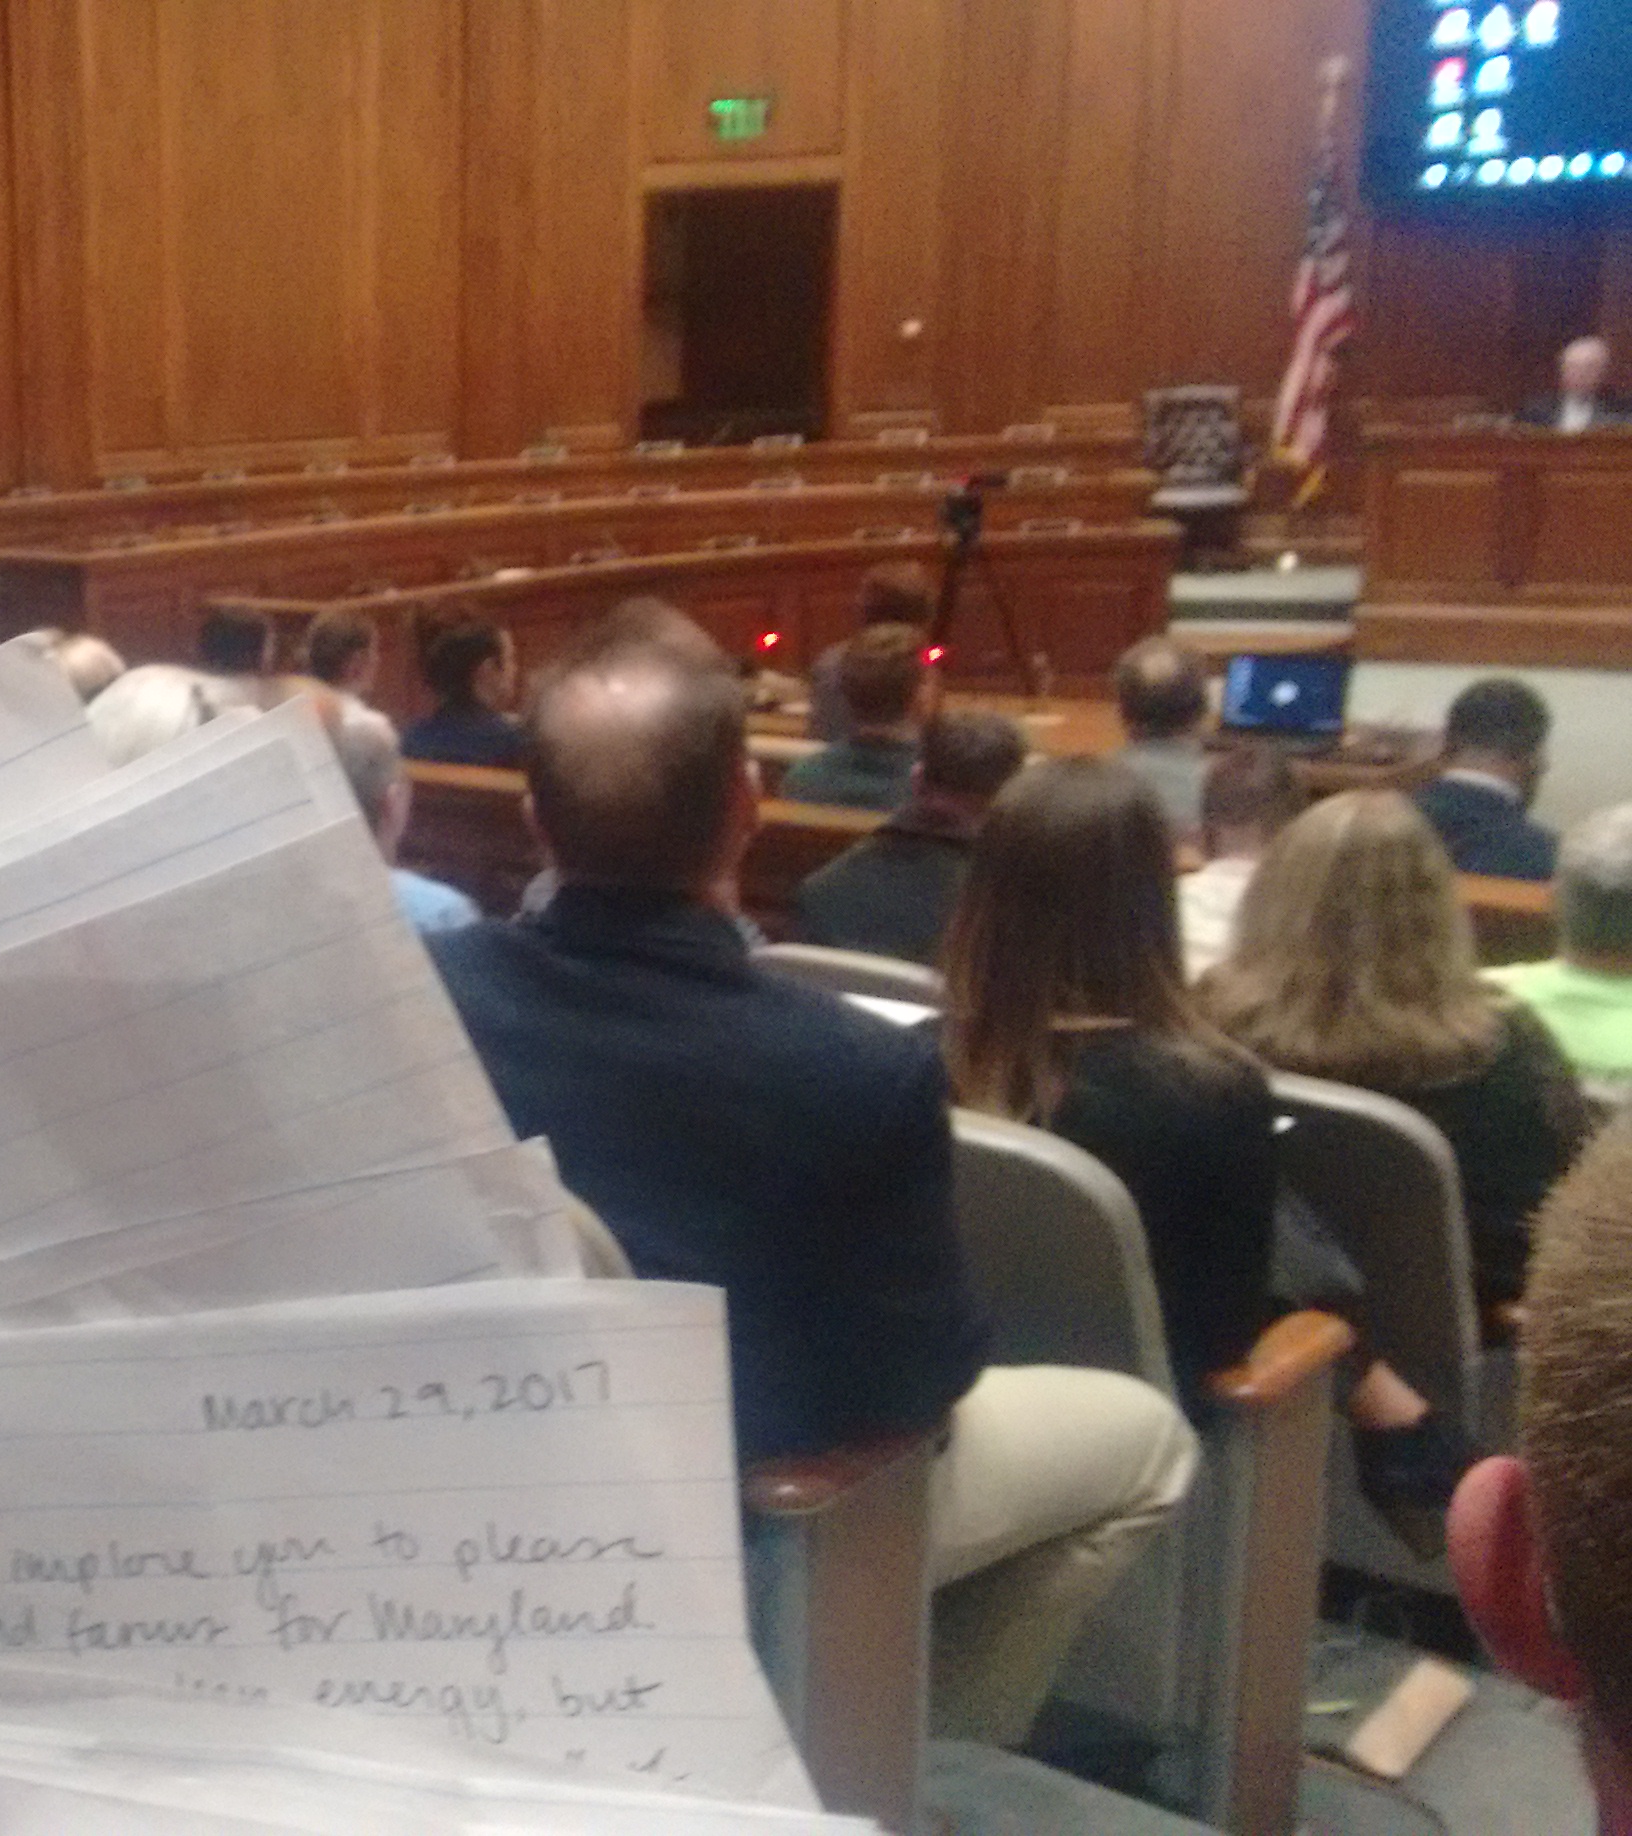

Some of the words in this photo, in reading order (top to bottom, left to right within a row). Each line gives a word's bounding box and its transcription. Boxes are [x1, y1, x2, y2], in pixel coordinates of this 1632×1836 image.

[202, 1389, 356, 1432] March
[372, 1520, 420, 1561] to
[453, 1521, 664, 1582] please
[268, 1593, 351, 1652] for
[551, 1676, 663, 1717] but
